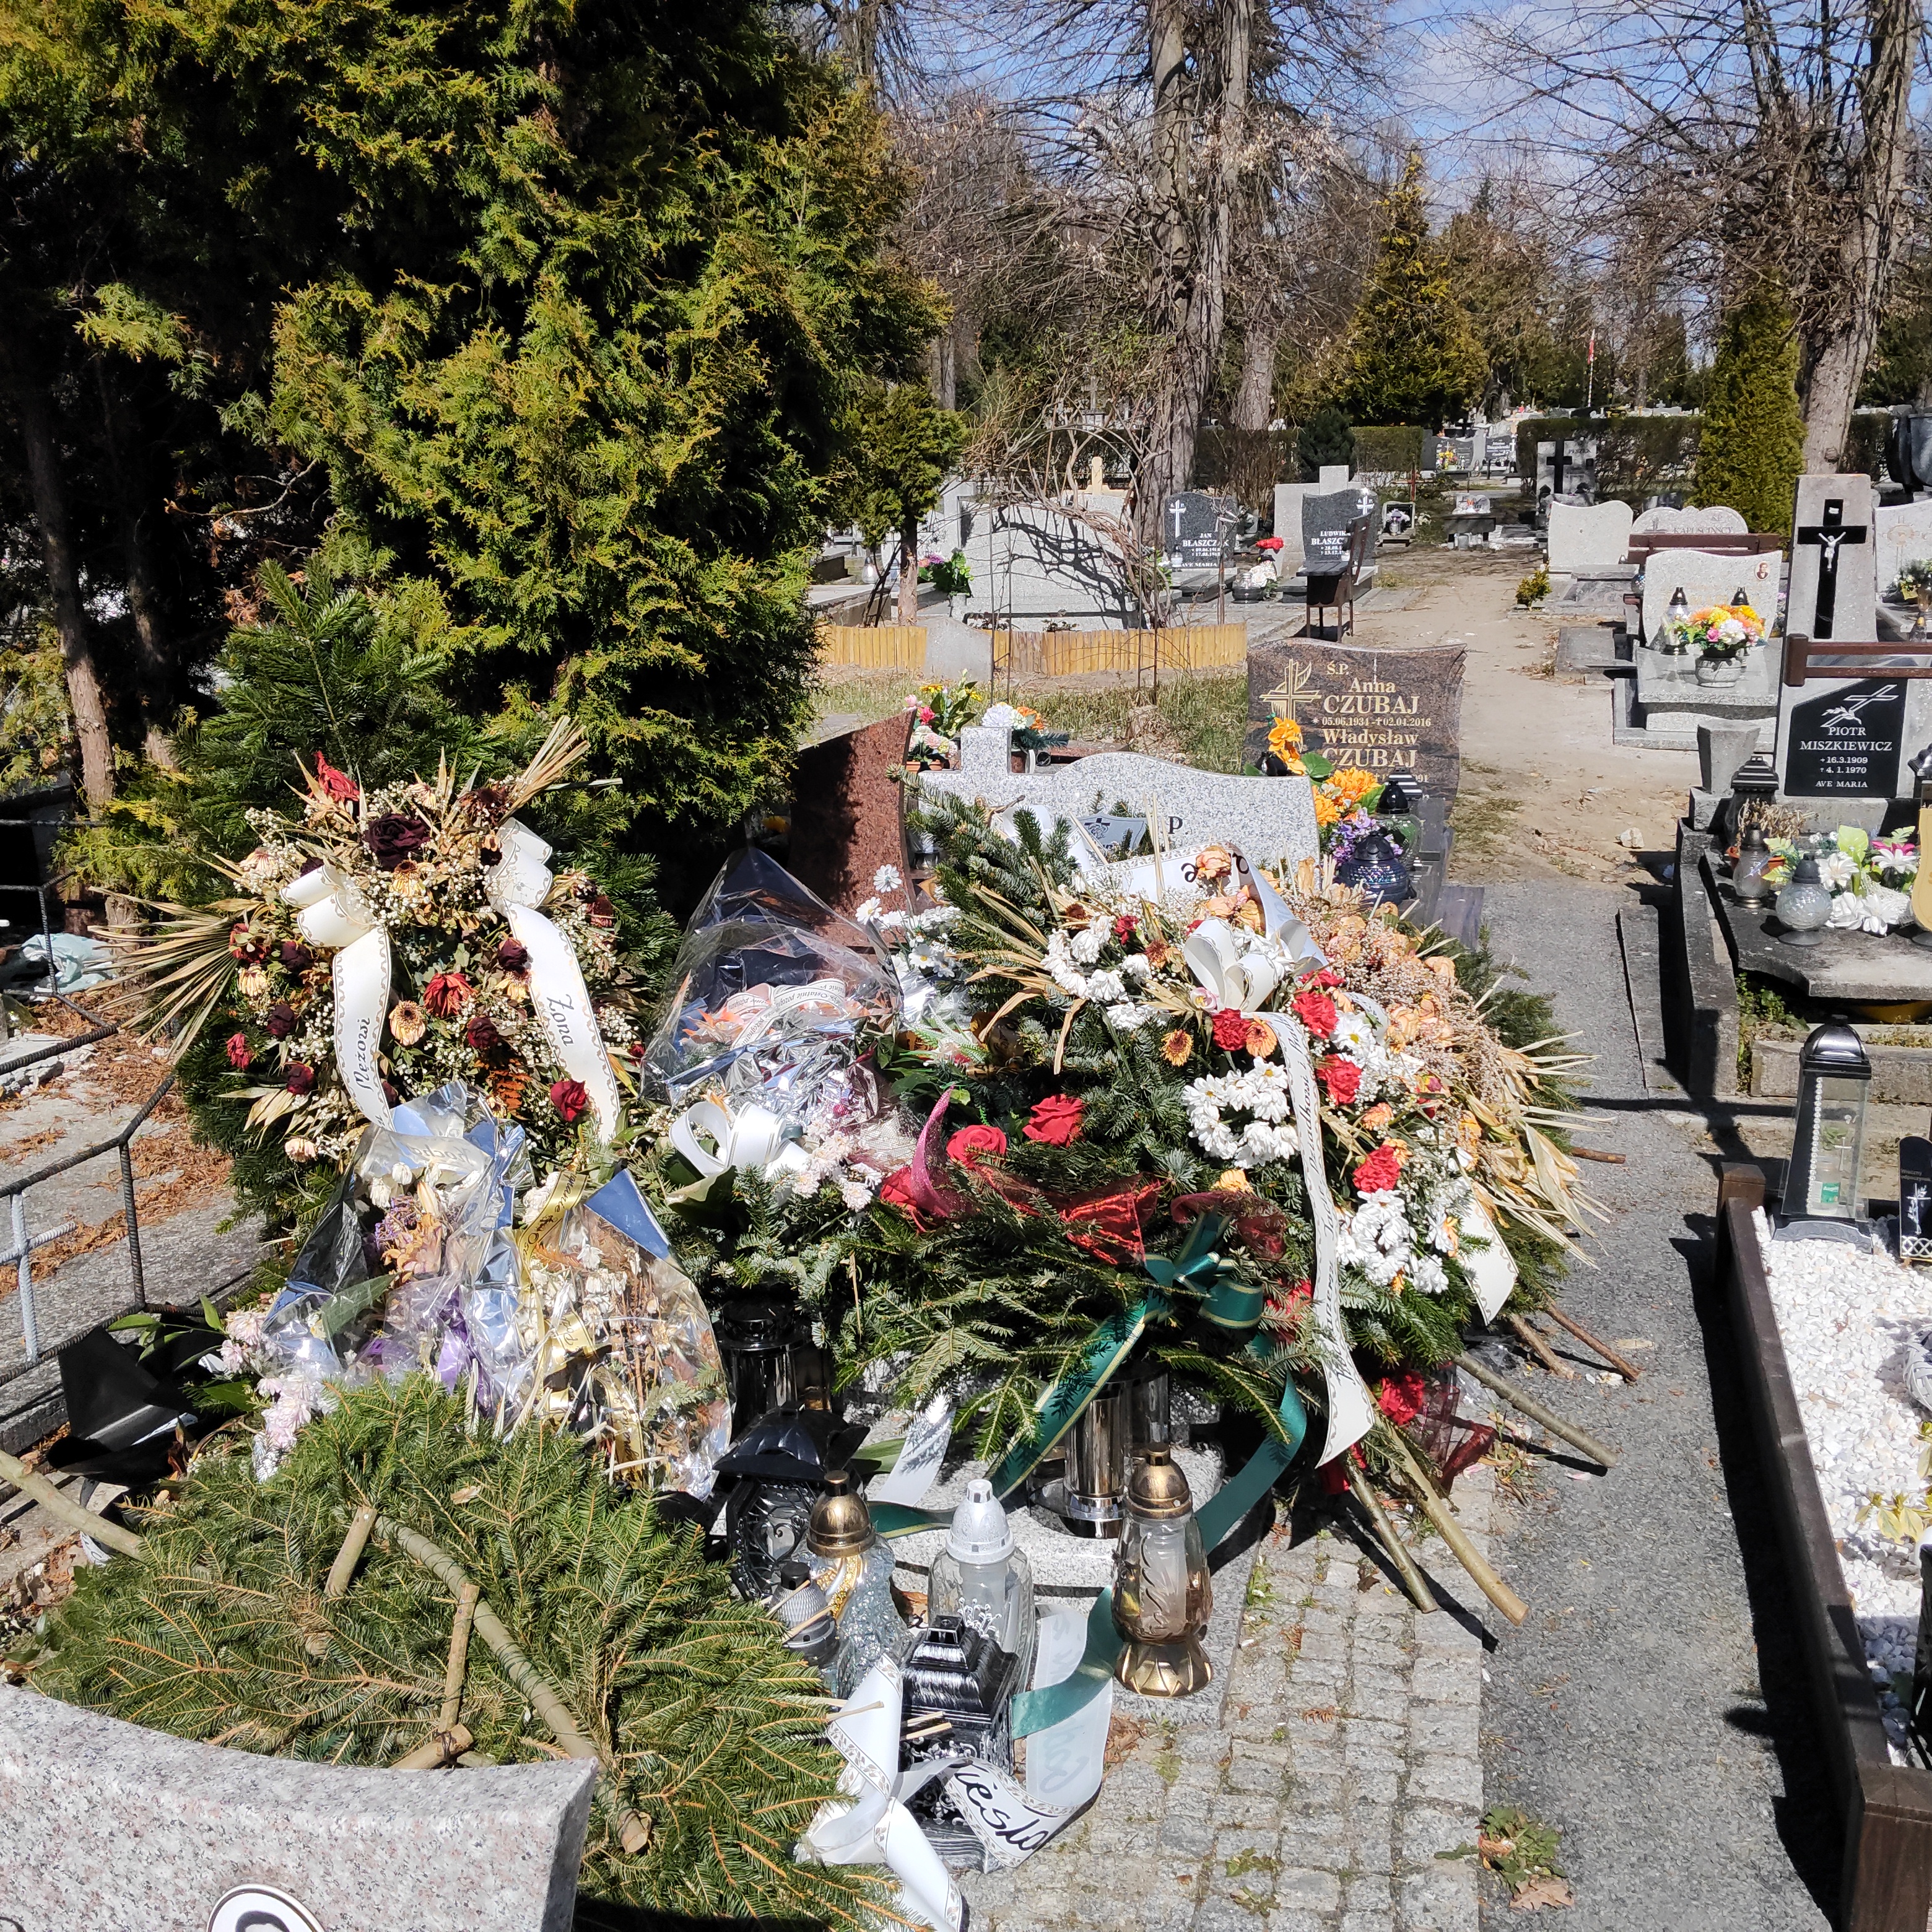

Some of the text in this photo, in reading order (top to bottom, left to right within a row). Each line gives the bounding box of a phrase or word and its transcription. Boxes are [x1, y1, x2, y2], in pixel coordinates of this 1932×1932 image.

[1347, 677, 1396, 694] Anna
[1323, 694, 1421, 715] CZUBAJ
[1321, 728, 1419, 747] Władysław
[1827, 726, 1866, 736] PIOTR
[1799, 740, 1893, 751] MISZKIEWICZ
[1321, 747, 1418, 768] CZUBAJ
